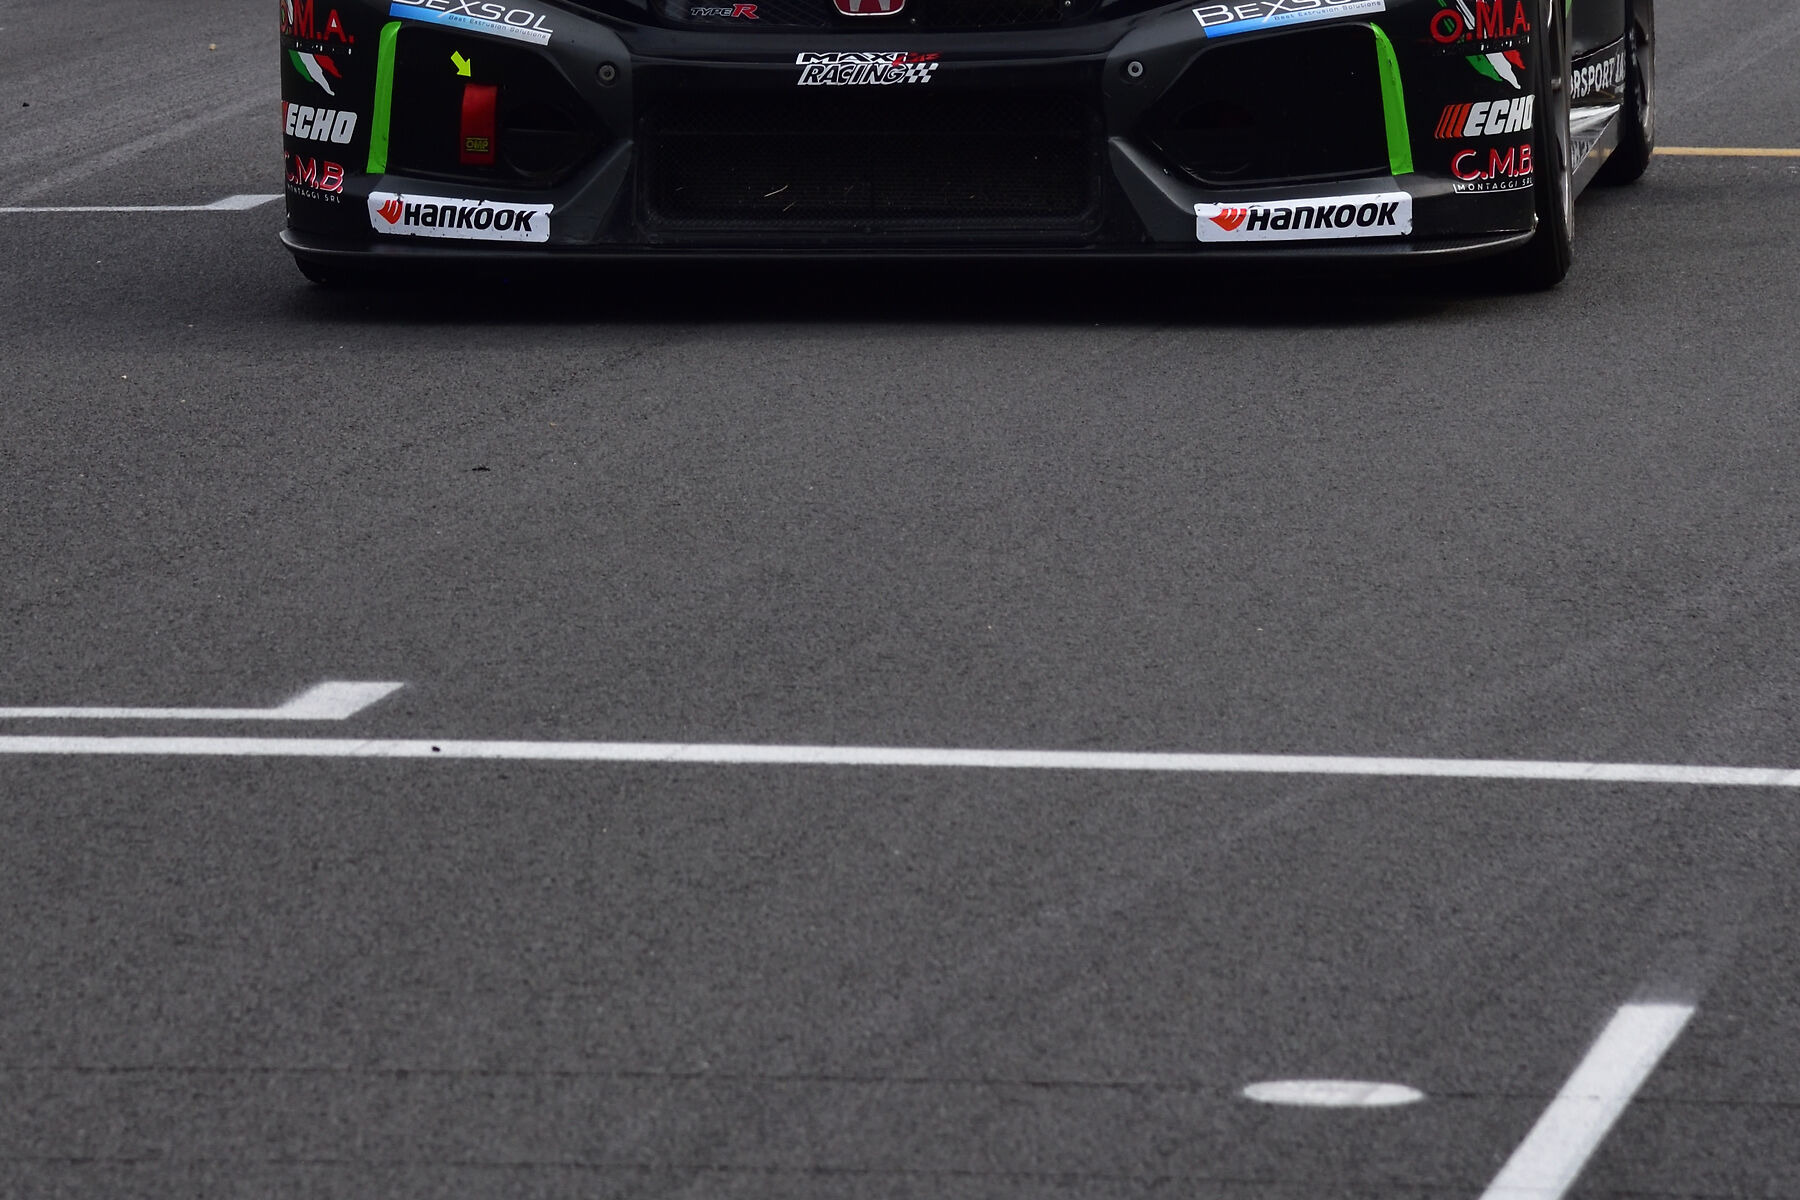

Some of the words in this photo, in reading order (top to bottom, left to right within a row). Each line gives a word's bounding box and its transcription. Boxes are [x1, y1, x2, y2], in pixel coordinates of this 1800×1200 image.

[731, 3, 760, 19] R
[797, 64, 910, 86] RACING
[286, 102, 358, 144] ECHO
[1463, 94, 1536, 137] ECHO
[1457, 180, 1518, 191] MONTAGGI
